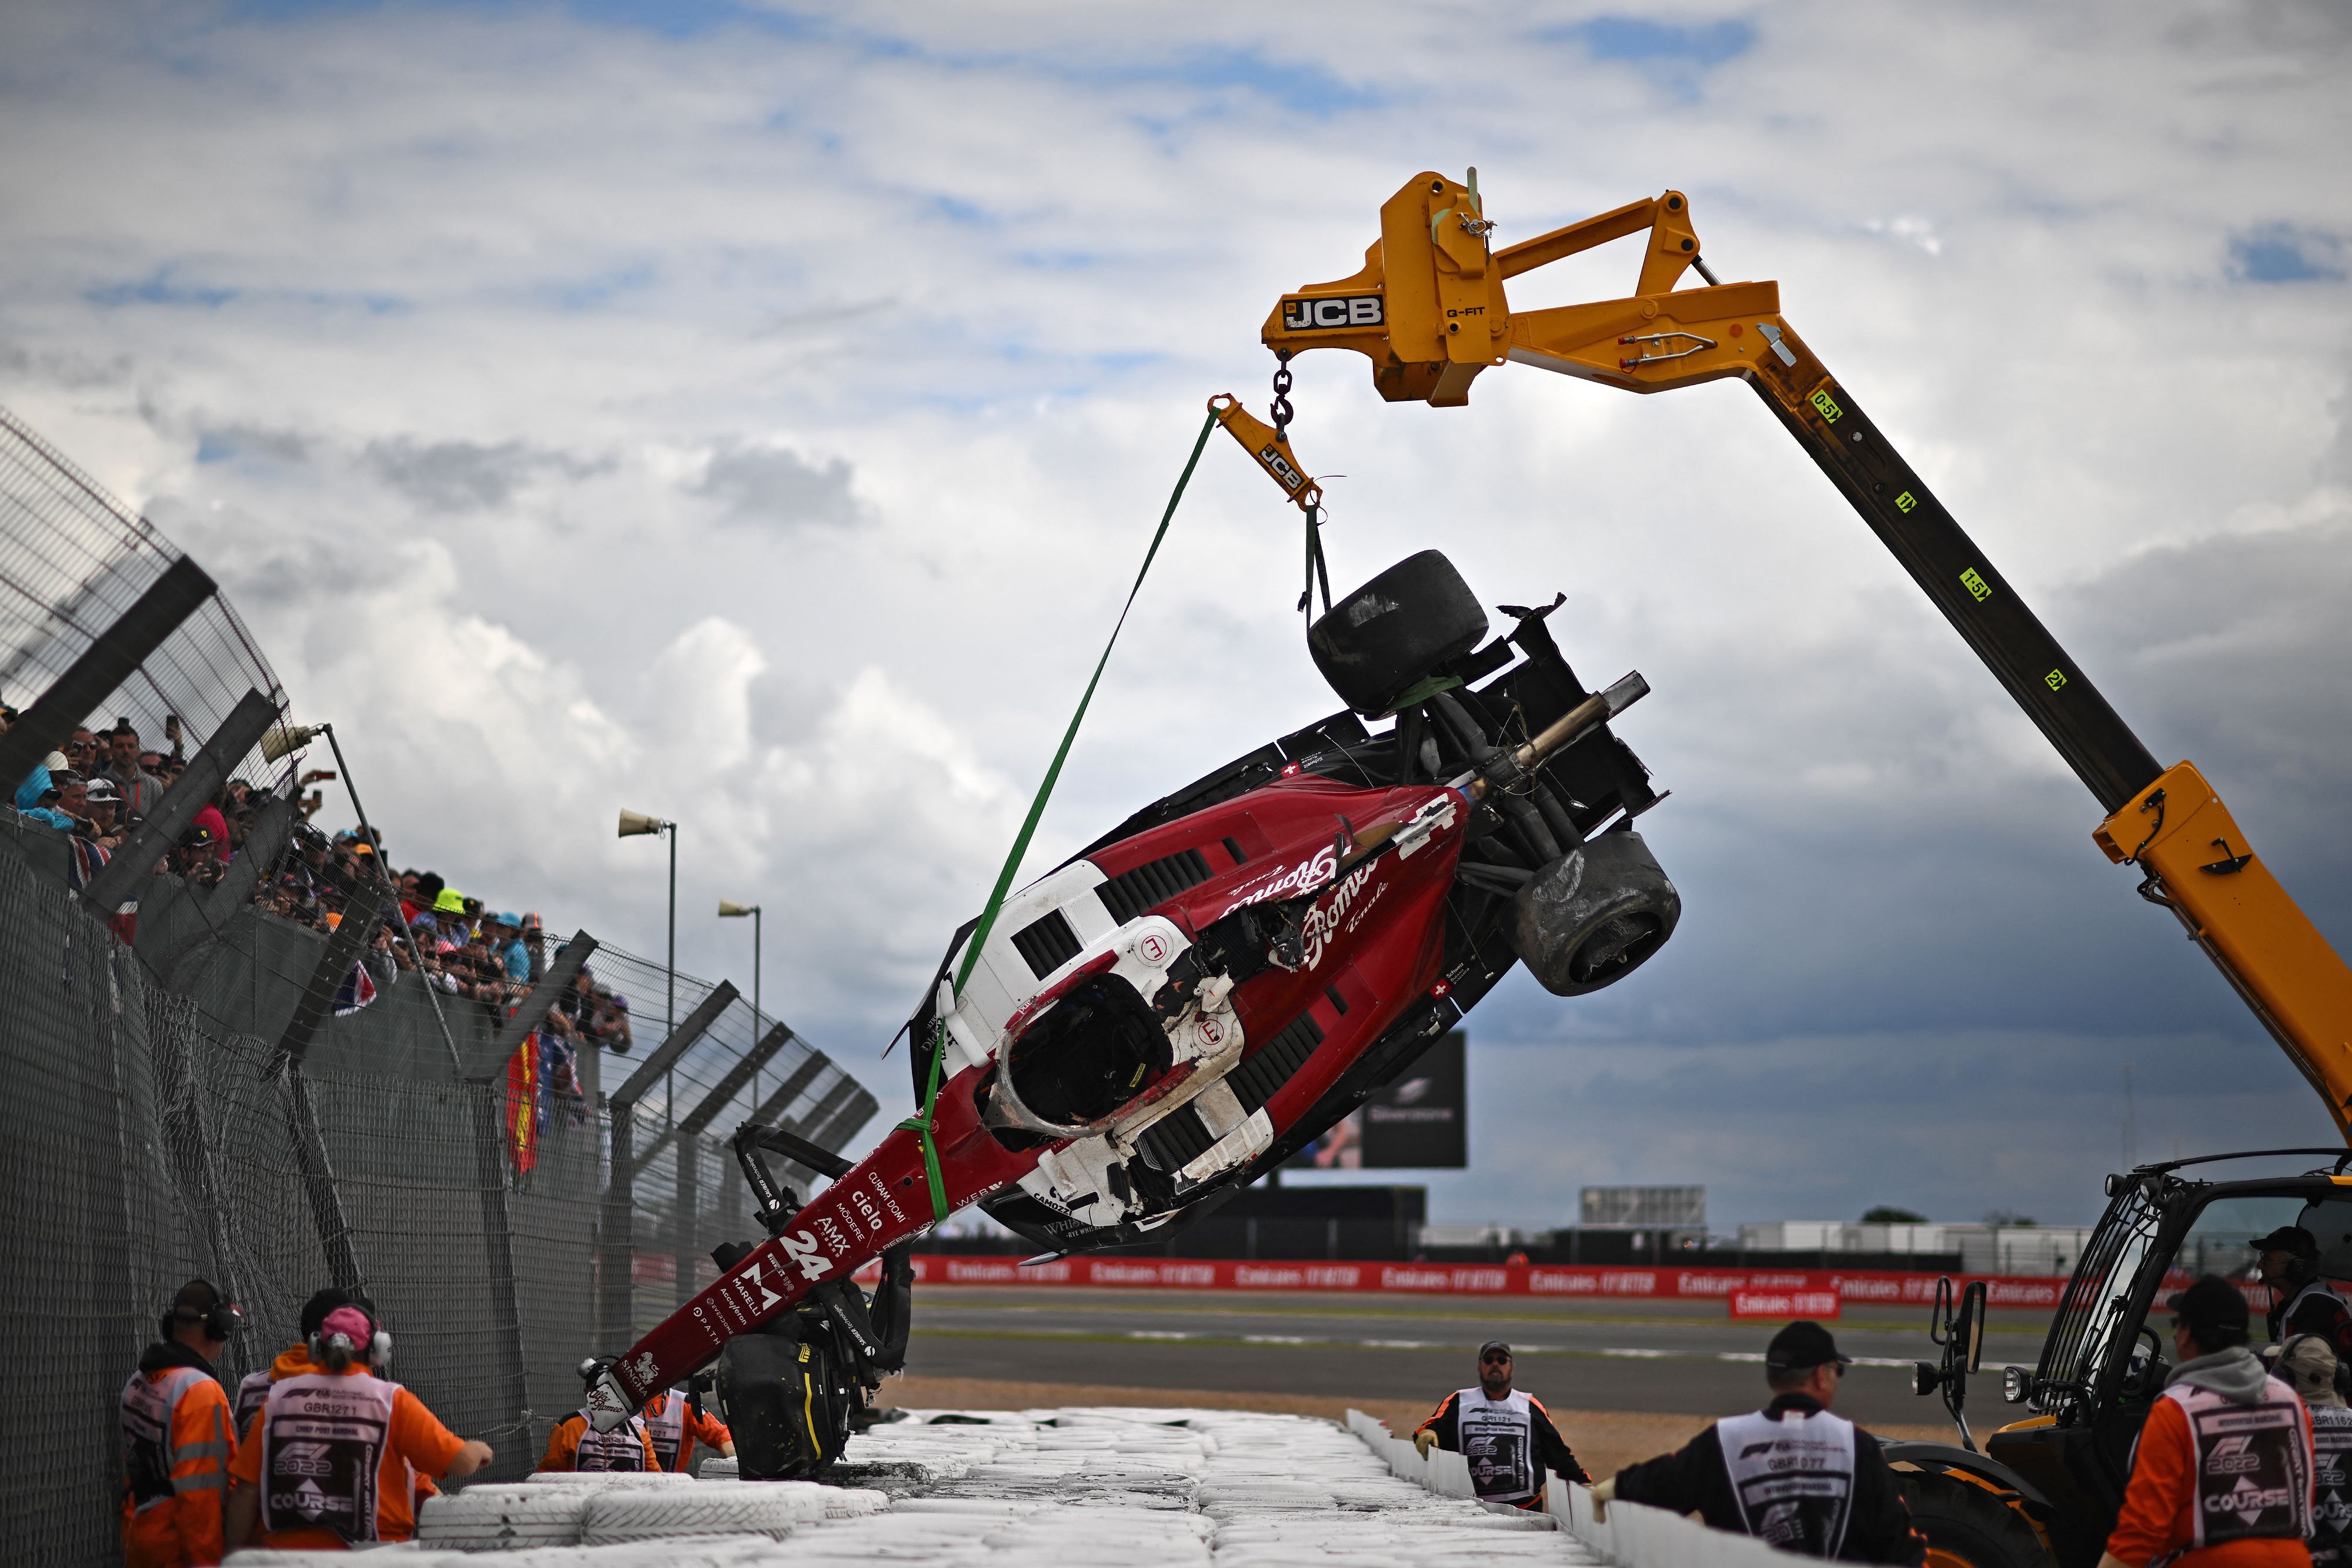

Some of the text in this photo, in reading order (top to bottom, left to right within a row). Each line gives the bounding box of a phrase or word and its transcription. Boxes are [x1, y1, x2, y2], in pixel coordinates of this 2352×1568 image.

[1287, 297, 1381, 328] JCB
[1447, 307, 1485, 317] Q-FIT
[1261, 450, 1302, 489] JCB
[1900, 495, 1910, 506] 1
[2047, 672, 2060, 684] 2
[1304, 757, 1323, 769] Schweiz
[1345, 882, 1388, 932] Tonale
[1446, 962, 1464, 978] Schweiz
[759, 1179, 773, 1198] SAUBER
[869, 1172, 906, 1223] CURAM DOMI
[957, 1188, 988, 1207] WEB
[853, 1191, 882, 1230] cielo
[1034, 1193, 1073, 1216] CAMOZZI
[817, 1218, 851, 1255] AMX
[780, 1230, 833, 1281] 24
[733, 1278, 761, 1316] MARELLI
[700, 1318, 721, 1345] PATH
[834, 1304, 867, 1346] SAUBER Technologies
[622, 1360, 647, 1396] SINGHA
[589, 1390, 610, 1402] Alfa
[590, 1400, 623, 1413] Romeo
[1466, 1445, 1498, 1457] 2022
[274, 1459, 333, 1477] 2022
[1471, 1465, 1512, 1476] OURSE
[2206, 1454, 2260, 1475] 2022
[270, 1492, 353, 1512] COURSE
[2206, 1487, 2288, 1513] COURSE
